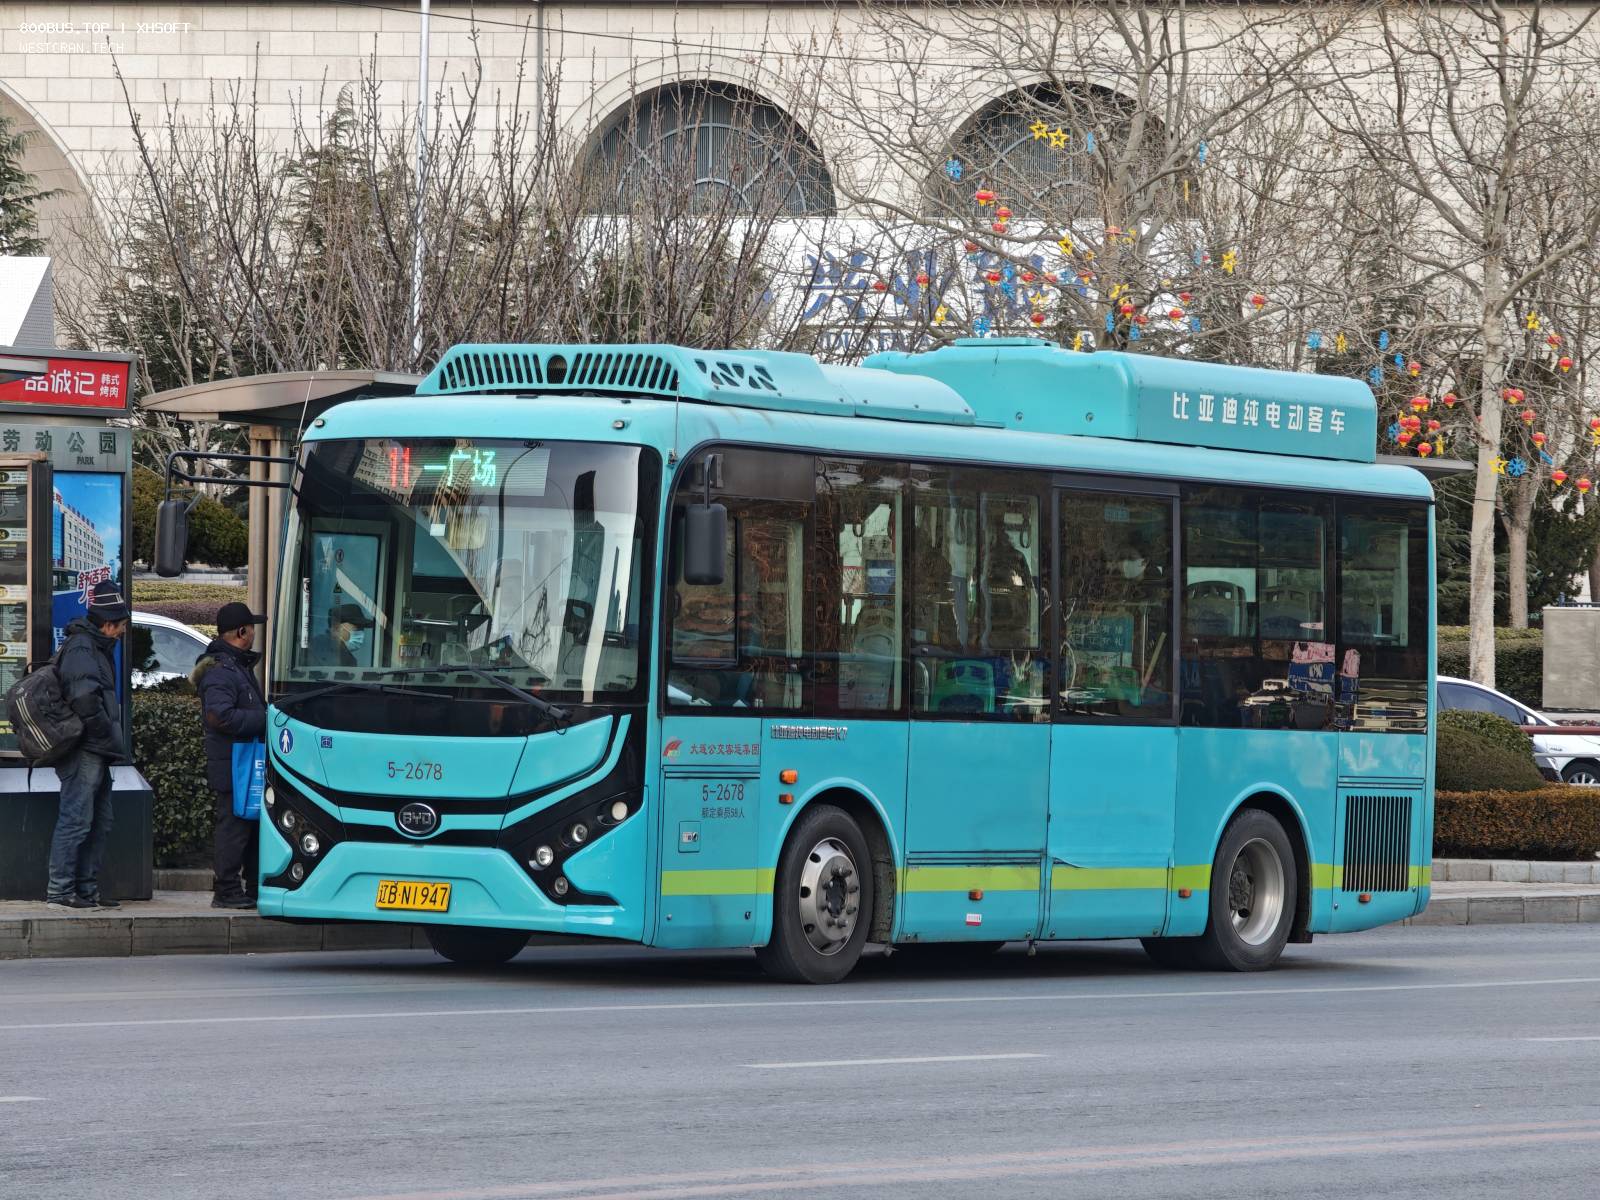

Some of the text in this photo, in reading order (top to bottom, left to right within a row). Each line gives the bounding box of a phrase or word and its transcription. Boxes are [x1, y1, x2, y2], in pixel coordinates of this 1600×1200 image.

[24, 368, 95, 396] 品诚记
[1172, 391, 1346, 435] 比亚迪纯电动客车
[3, 429, 117, 455] 劳动公园
[76, 456, 95, 466] PARK
[387, 761, 443, 781] 5-2678
[702, 783, 745, 802] 5-2678
[402, 811, 433, 826] BYD
